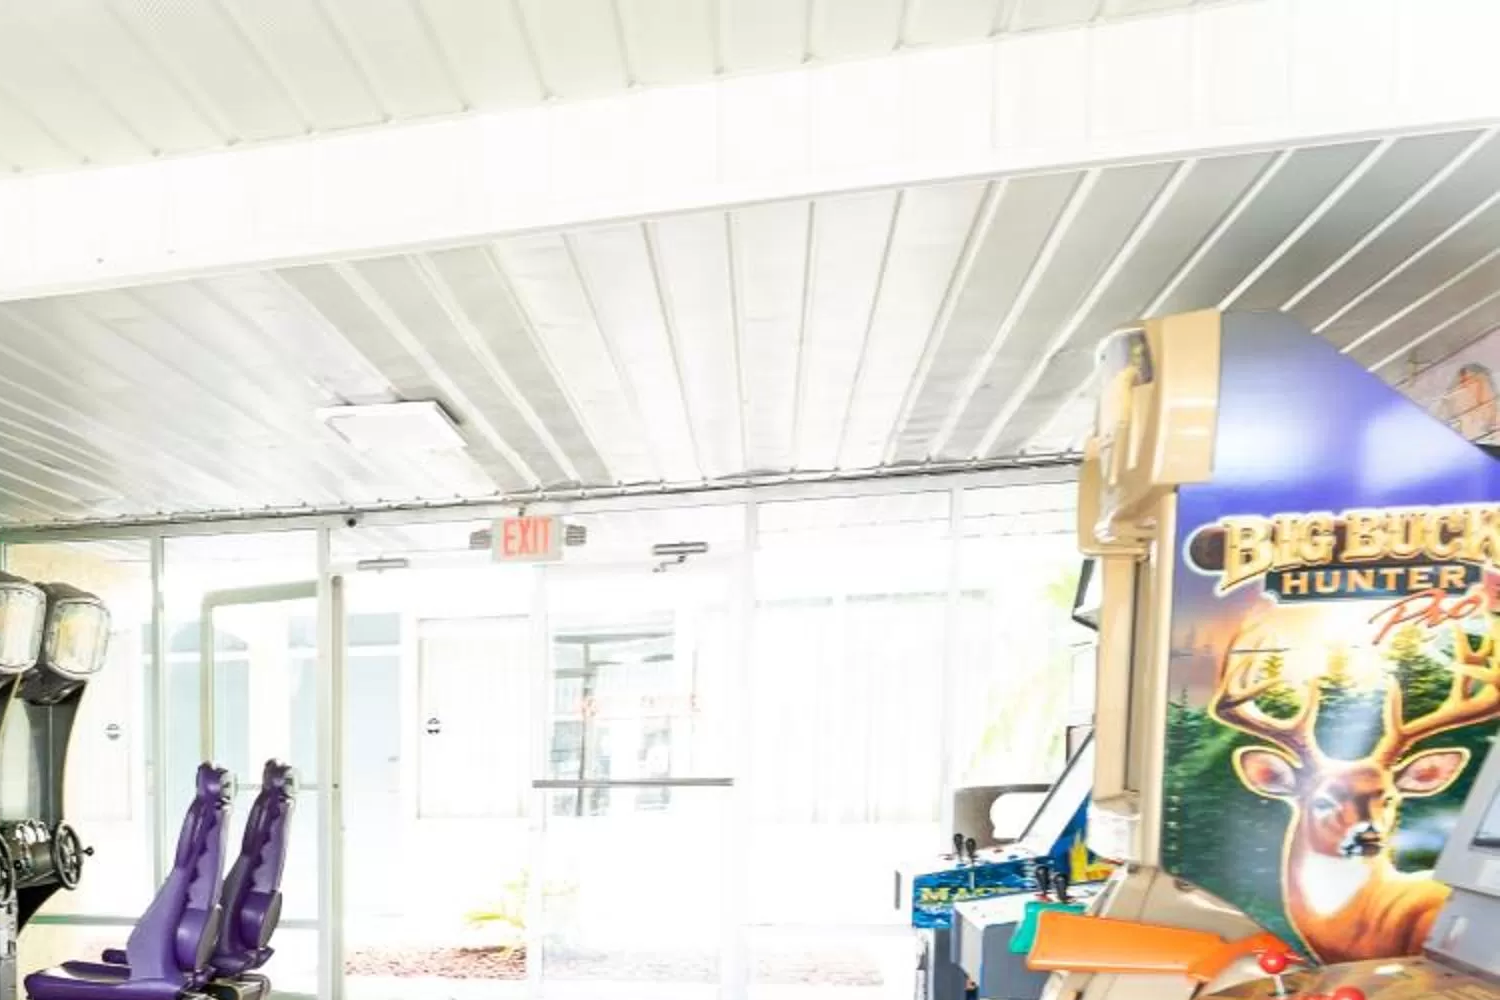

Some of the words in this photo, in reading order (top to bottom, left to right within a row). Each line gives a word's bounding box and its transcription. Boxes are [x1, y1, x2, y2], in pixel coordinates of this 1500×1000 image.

[503, 517, 553, 556] EXIT
[1221, 511, 1338, 592] BIG
[1340, 503, 1500, 565] BUCK
[1281, 563, 1467, 595] HUNTER
[1368, 588, 1486, 646] Pro
